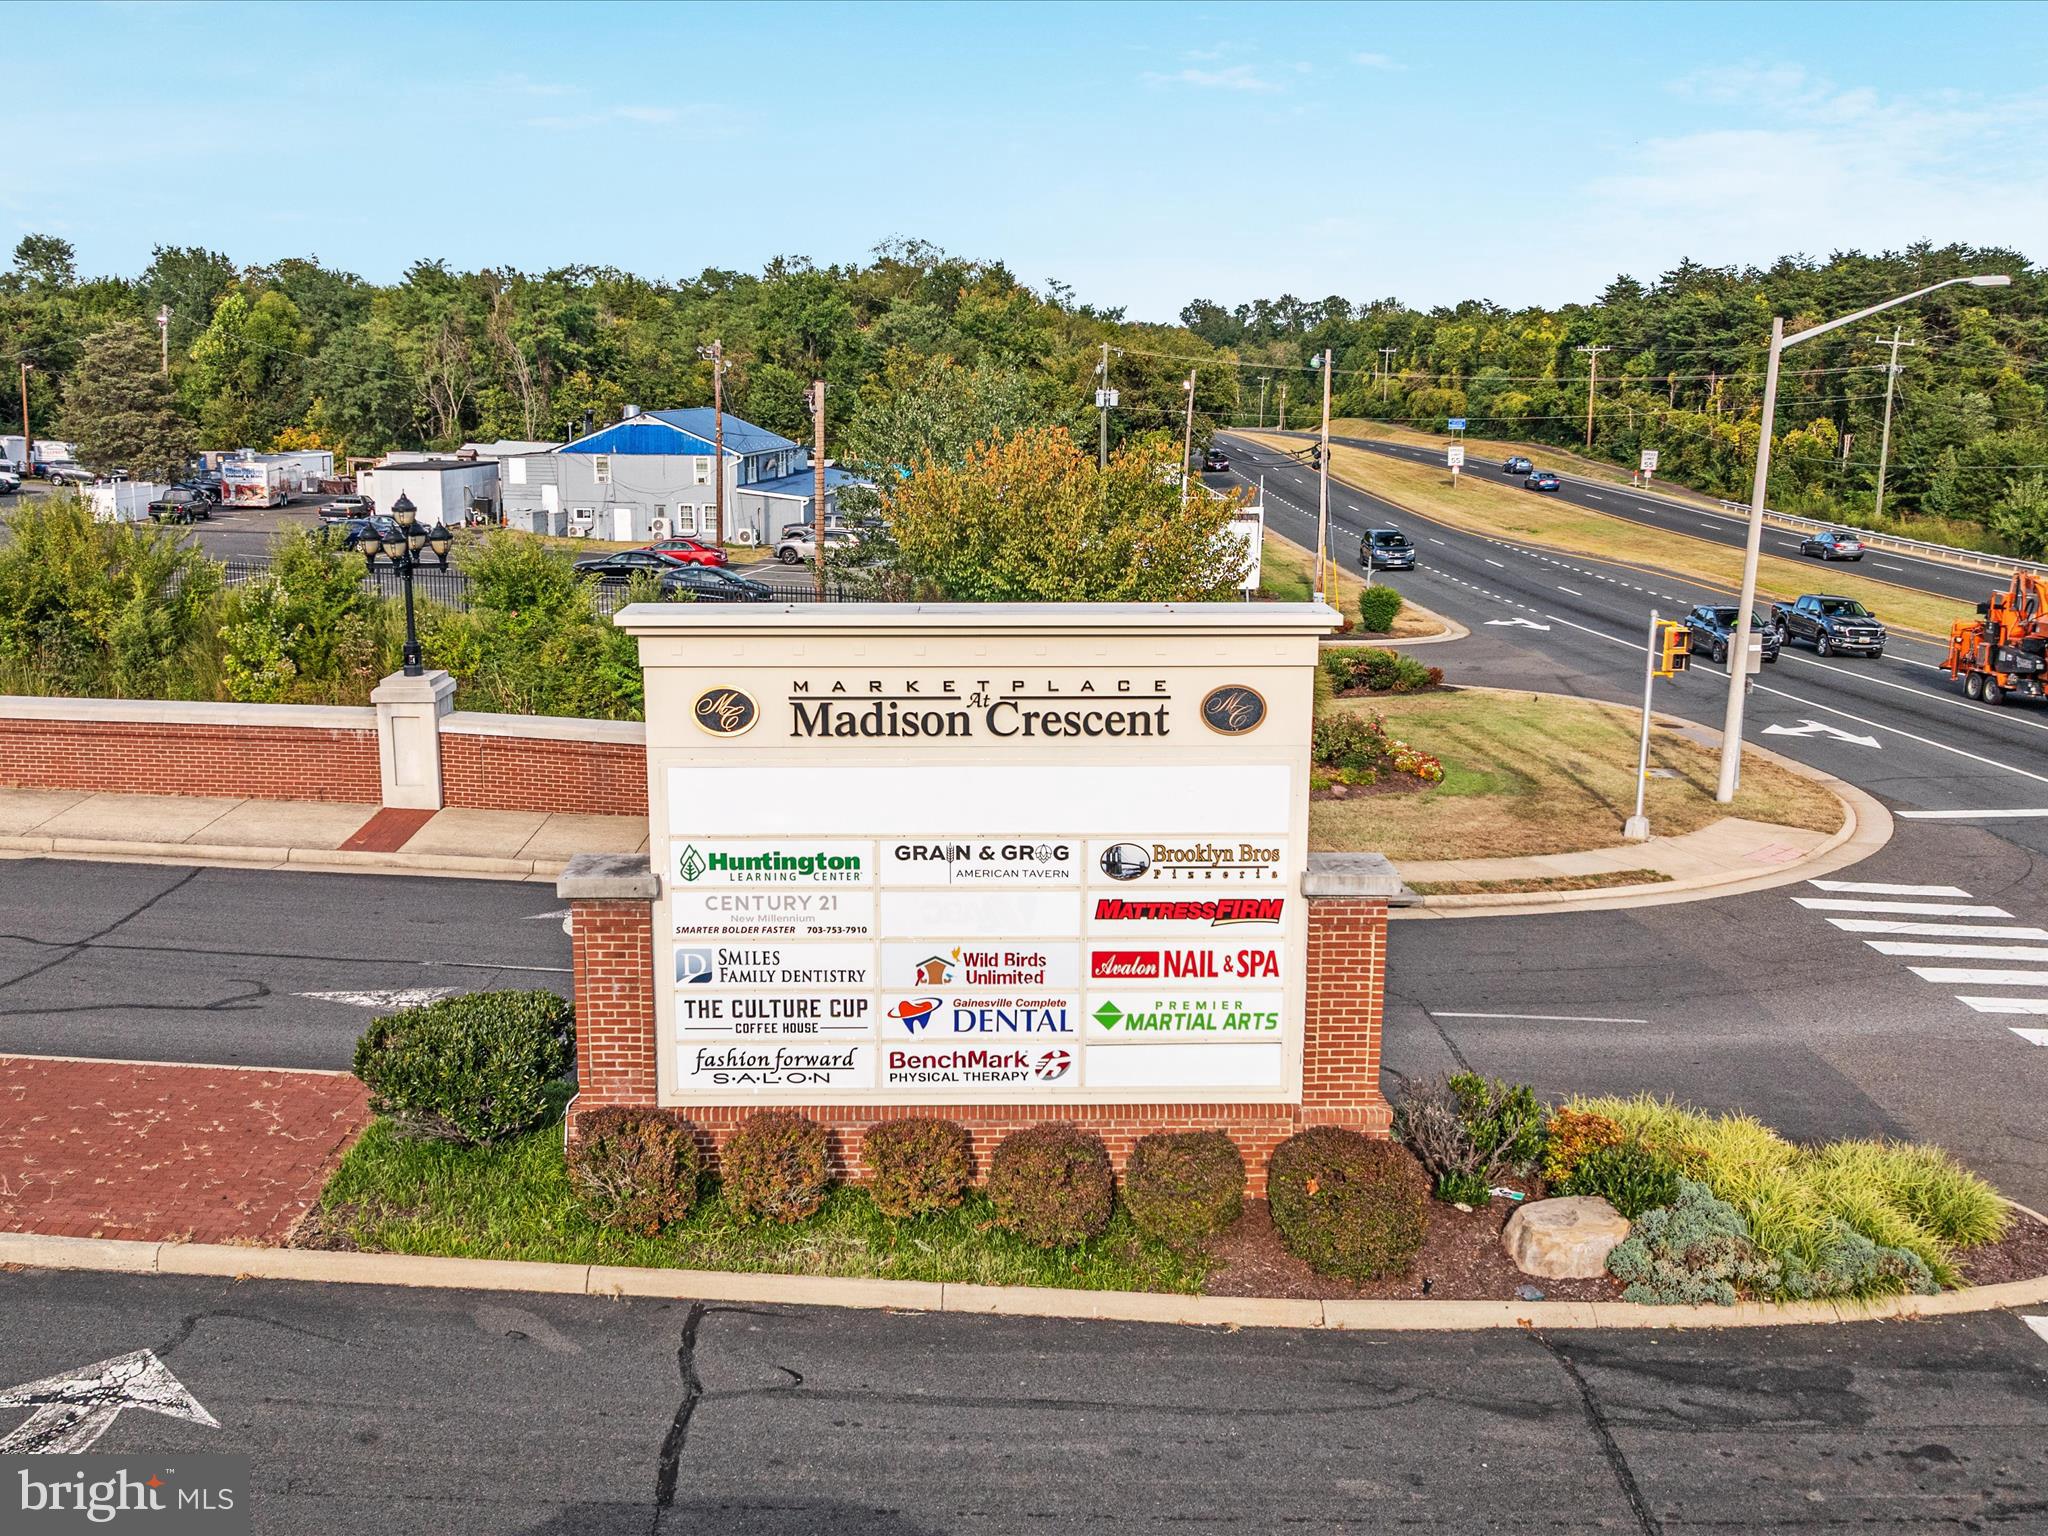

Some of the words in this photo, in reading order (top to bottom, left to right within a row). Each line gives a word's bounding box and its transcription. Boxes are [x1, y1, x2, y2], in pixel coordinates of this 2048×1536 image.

[793, 680, 1166, 692] MARKETPLACE
[966, 692, 990, 708] At
[789, 701, 973, 738] Madison
[986, 701, 1170, 737] Crescent
[978, 845, 995, 861] &
[1152, 843, 1234, 867] Brooklyn
[1238, 843, 1280, 862] Bros
[708, 851, 861, 875] Huntington
[729, 872, 797, 881] LEARNING
[813, 872, 861, 881] CENTER
[956, 869, 1019, 878] AMERICAN
[1023, 869, 1070, 878] TAVERN
[1153, 868, 1278, 879] Pizzeria
[705, 895, 812, 911] CENTURY
[818, 895, 838, 911] 21
[730, 914, 755, 923] New
[757, 914, 816, 923] Millennium
[675, 926, 720, 934] SMARTER
[722, 926, 759, 934] BOLDER
[761, 926, 796, 934] FASTER
[806, 926, 868, 934] 703-753-7910
[718, 948, 780, 966] SMILES
[963, 952, 998, 967] Wild
[1004, 952, 1047, 967] Birds
[1095, 954, 1157, 975] Avalon
[1163, 950, 1219, 978] NAIL
[1223, 955, 1234, 972] &
[1236, 950, 1280, 978] SPA
[719, 967, 776, 983] FAMILY
[781, 969, 866, 983] DENTISTRY
[966, 969, 1044, 985] Unlimited
[684, 999, 723, 1018] THE
[731, 999, 821, 1018] CULTURE
[829, 999, 869, 1018] CUP
[953, 998, 1012, 1008] Gainesville
[1015, 998, 1067, 1009] Complete
[1155, 1000, 1243, 1010] PREMIER
[735, 1023, 778, 1034] COFFEE
[782, 1022, 819, 1034] HOUSE
[953, 1009, 1074, 1033] DENTAL
[1125, 1013, 1217, 1031] MARTIAL
[1222, 1012, 1279, 1031] ARTS
[691, 1047, 770, 1075] fashion
[770, 1047, 859, 1074] forward
[889, 1050, 1029, 1069] BenchMark
[889, 1071, 960, 1082] PHYSICAL
[963, 1071, 1029, 1082] THERAPY
